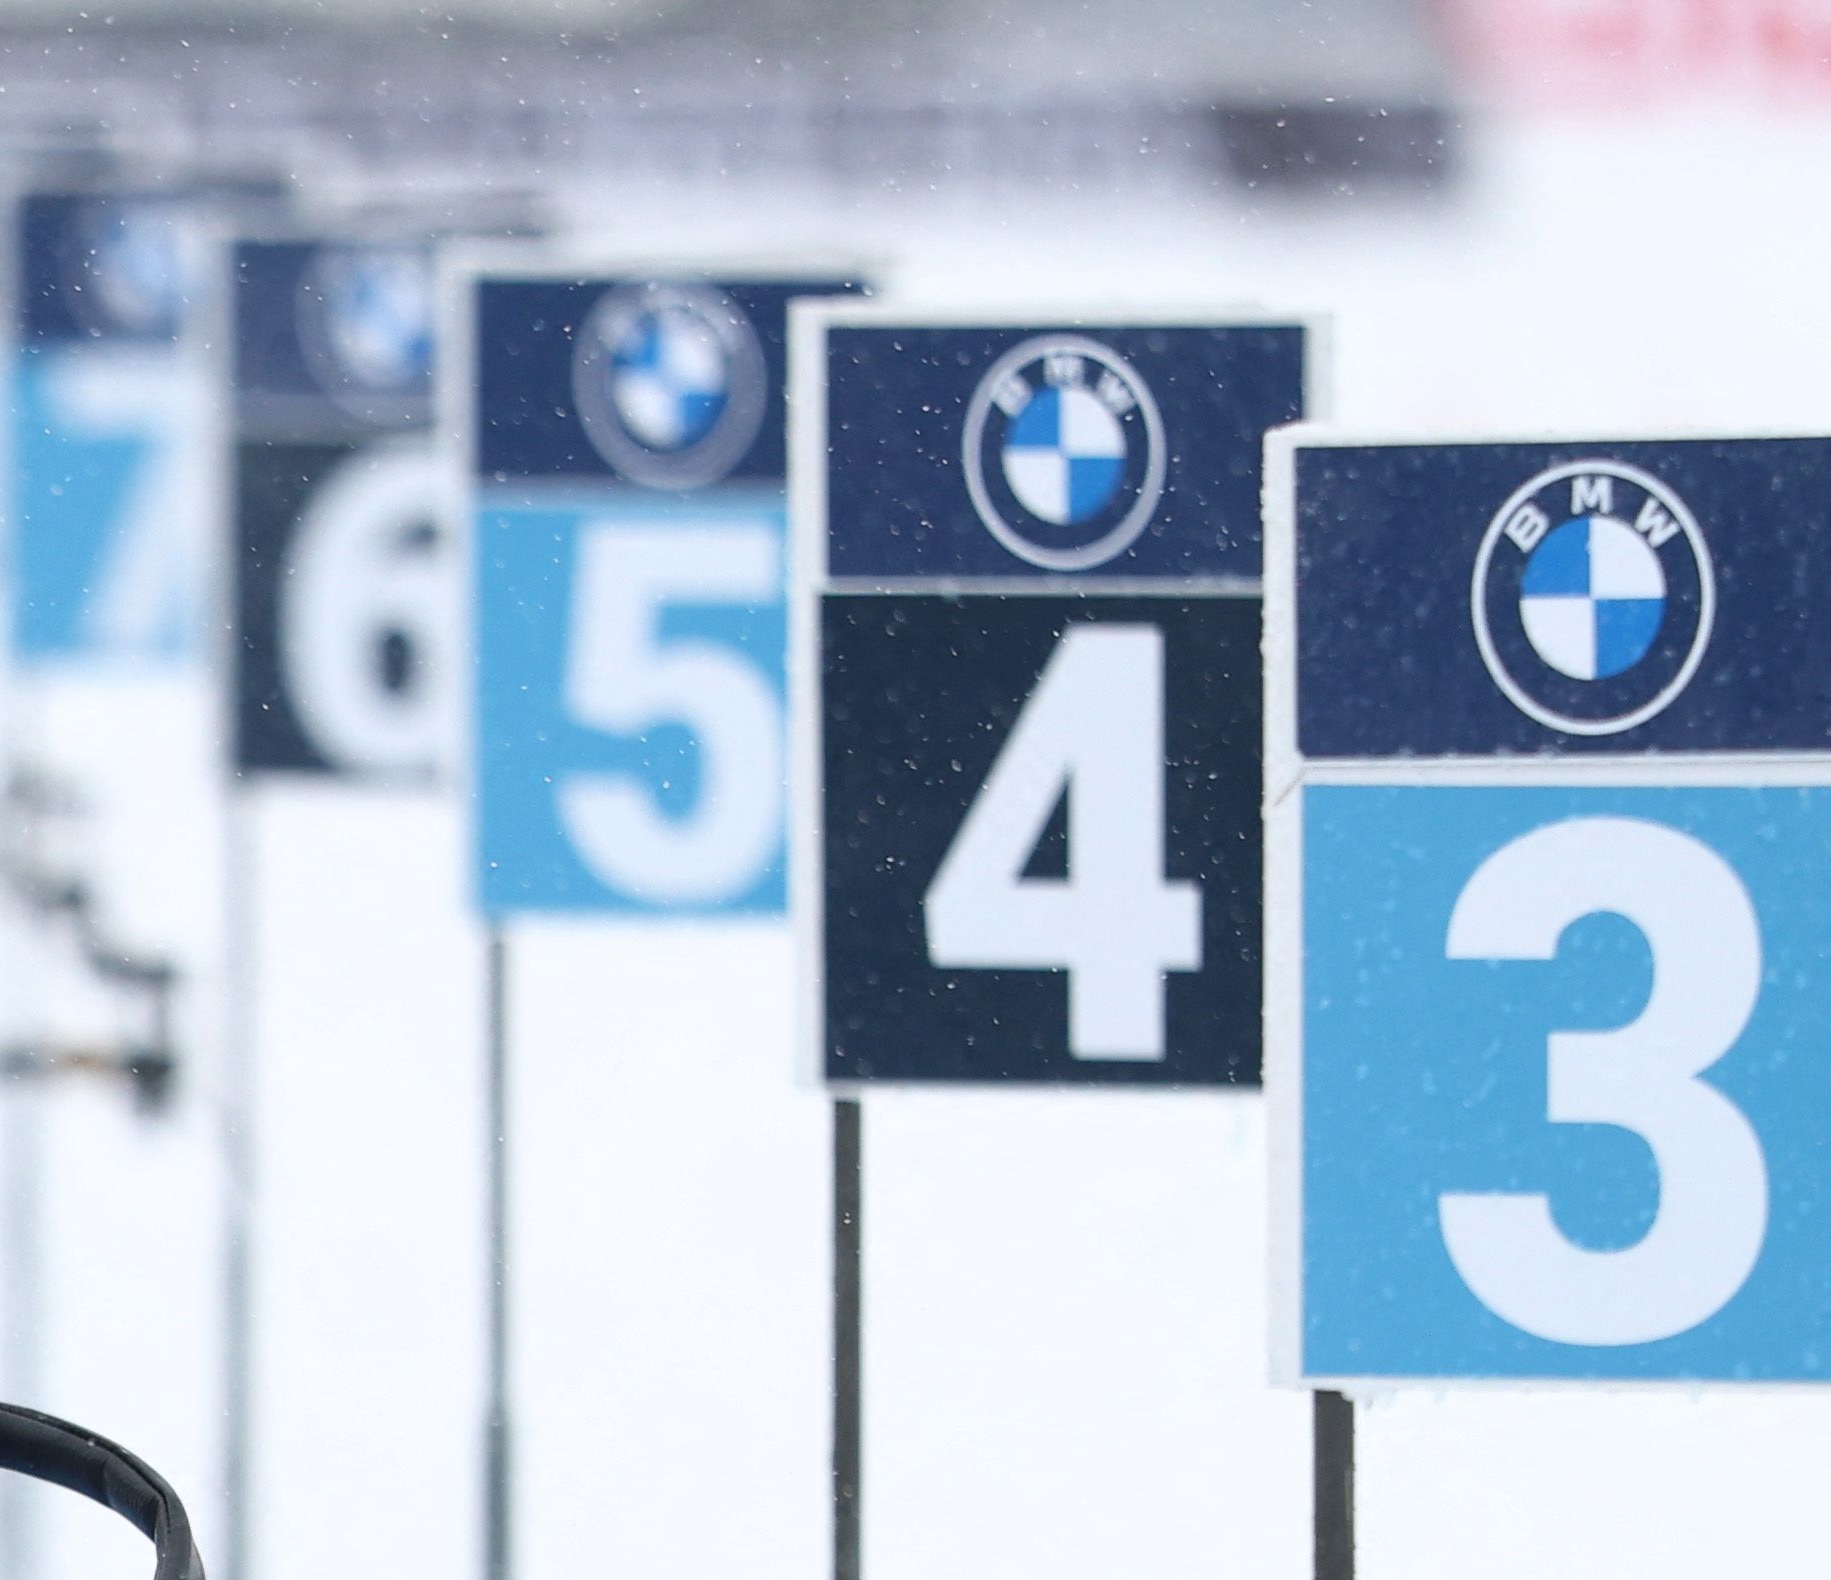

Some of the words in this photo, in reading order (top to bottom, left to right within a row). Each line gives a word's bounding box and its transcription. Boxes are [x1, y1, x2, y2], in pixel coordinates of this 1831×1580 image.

[283, 440, 454, 770] 6
[1504, 475, 1679, 553] BMW
[560, 522, 786, 907] 5
[923, 623, 1204, 1063] 4
[1438, 815, 1771, 1348] 3
